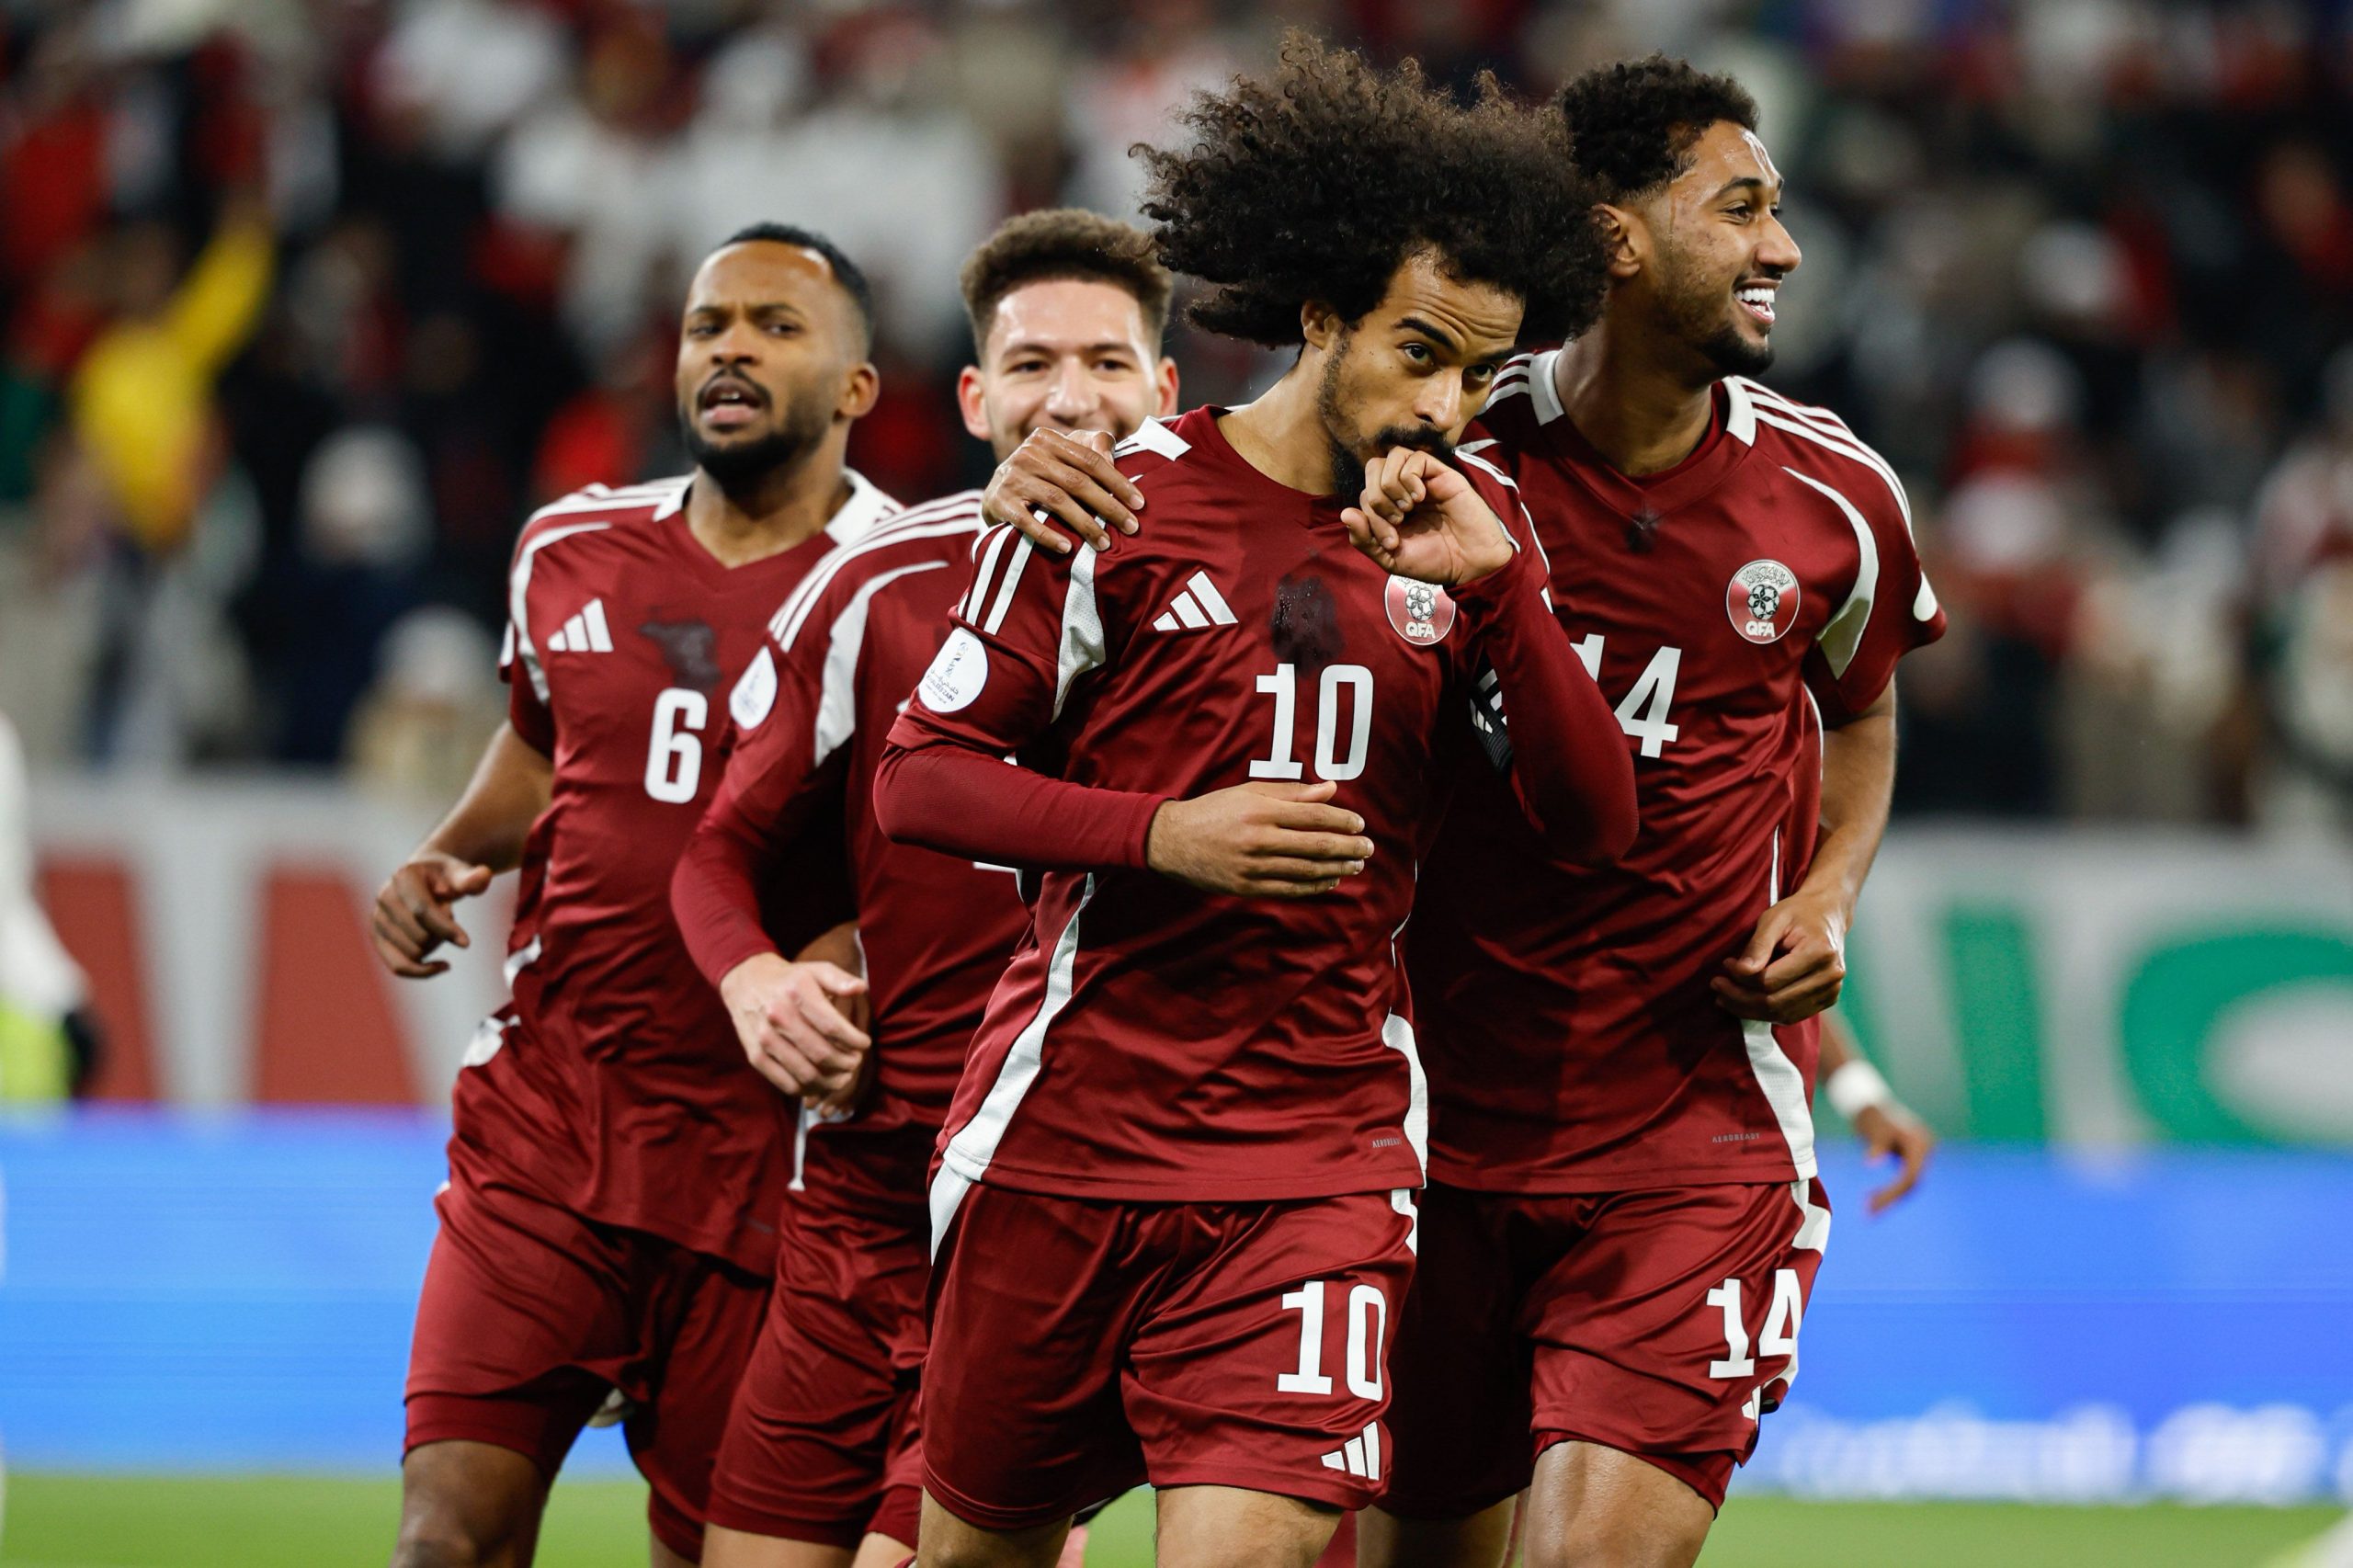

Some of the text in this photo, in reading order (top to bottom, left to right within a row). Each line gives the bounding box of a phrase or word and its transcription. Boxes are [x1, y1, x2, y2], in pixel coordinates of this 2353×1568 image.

[1405, 621, 1436, 639] QFA
[1745, 620, 1776, 638] QFA
[644, 687, 709, 804] 6
[1248, 663, 1374, 780] 10
[1712, 1132, 1760, 1142] AEROREADY
[1277, 1280, 1387, 1402] 10
[1706, 1268, 1802, 1380] 14
